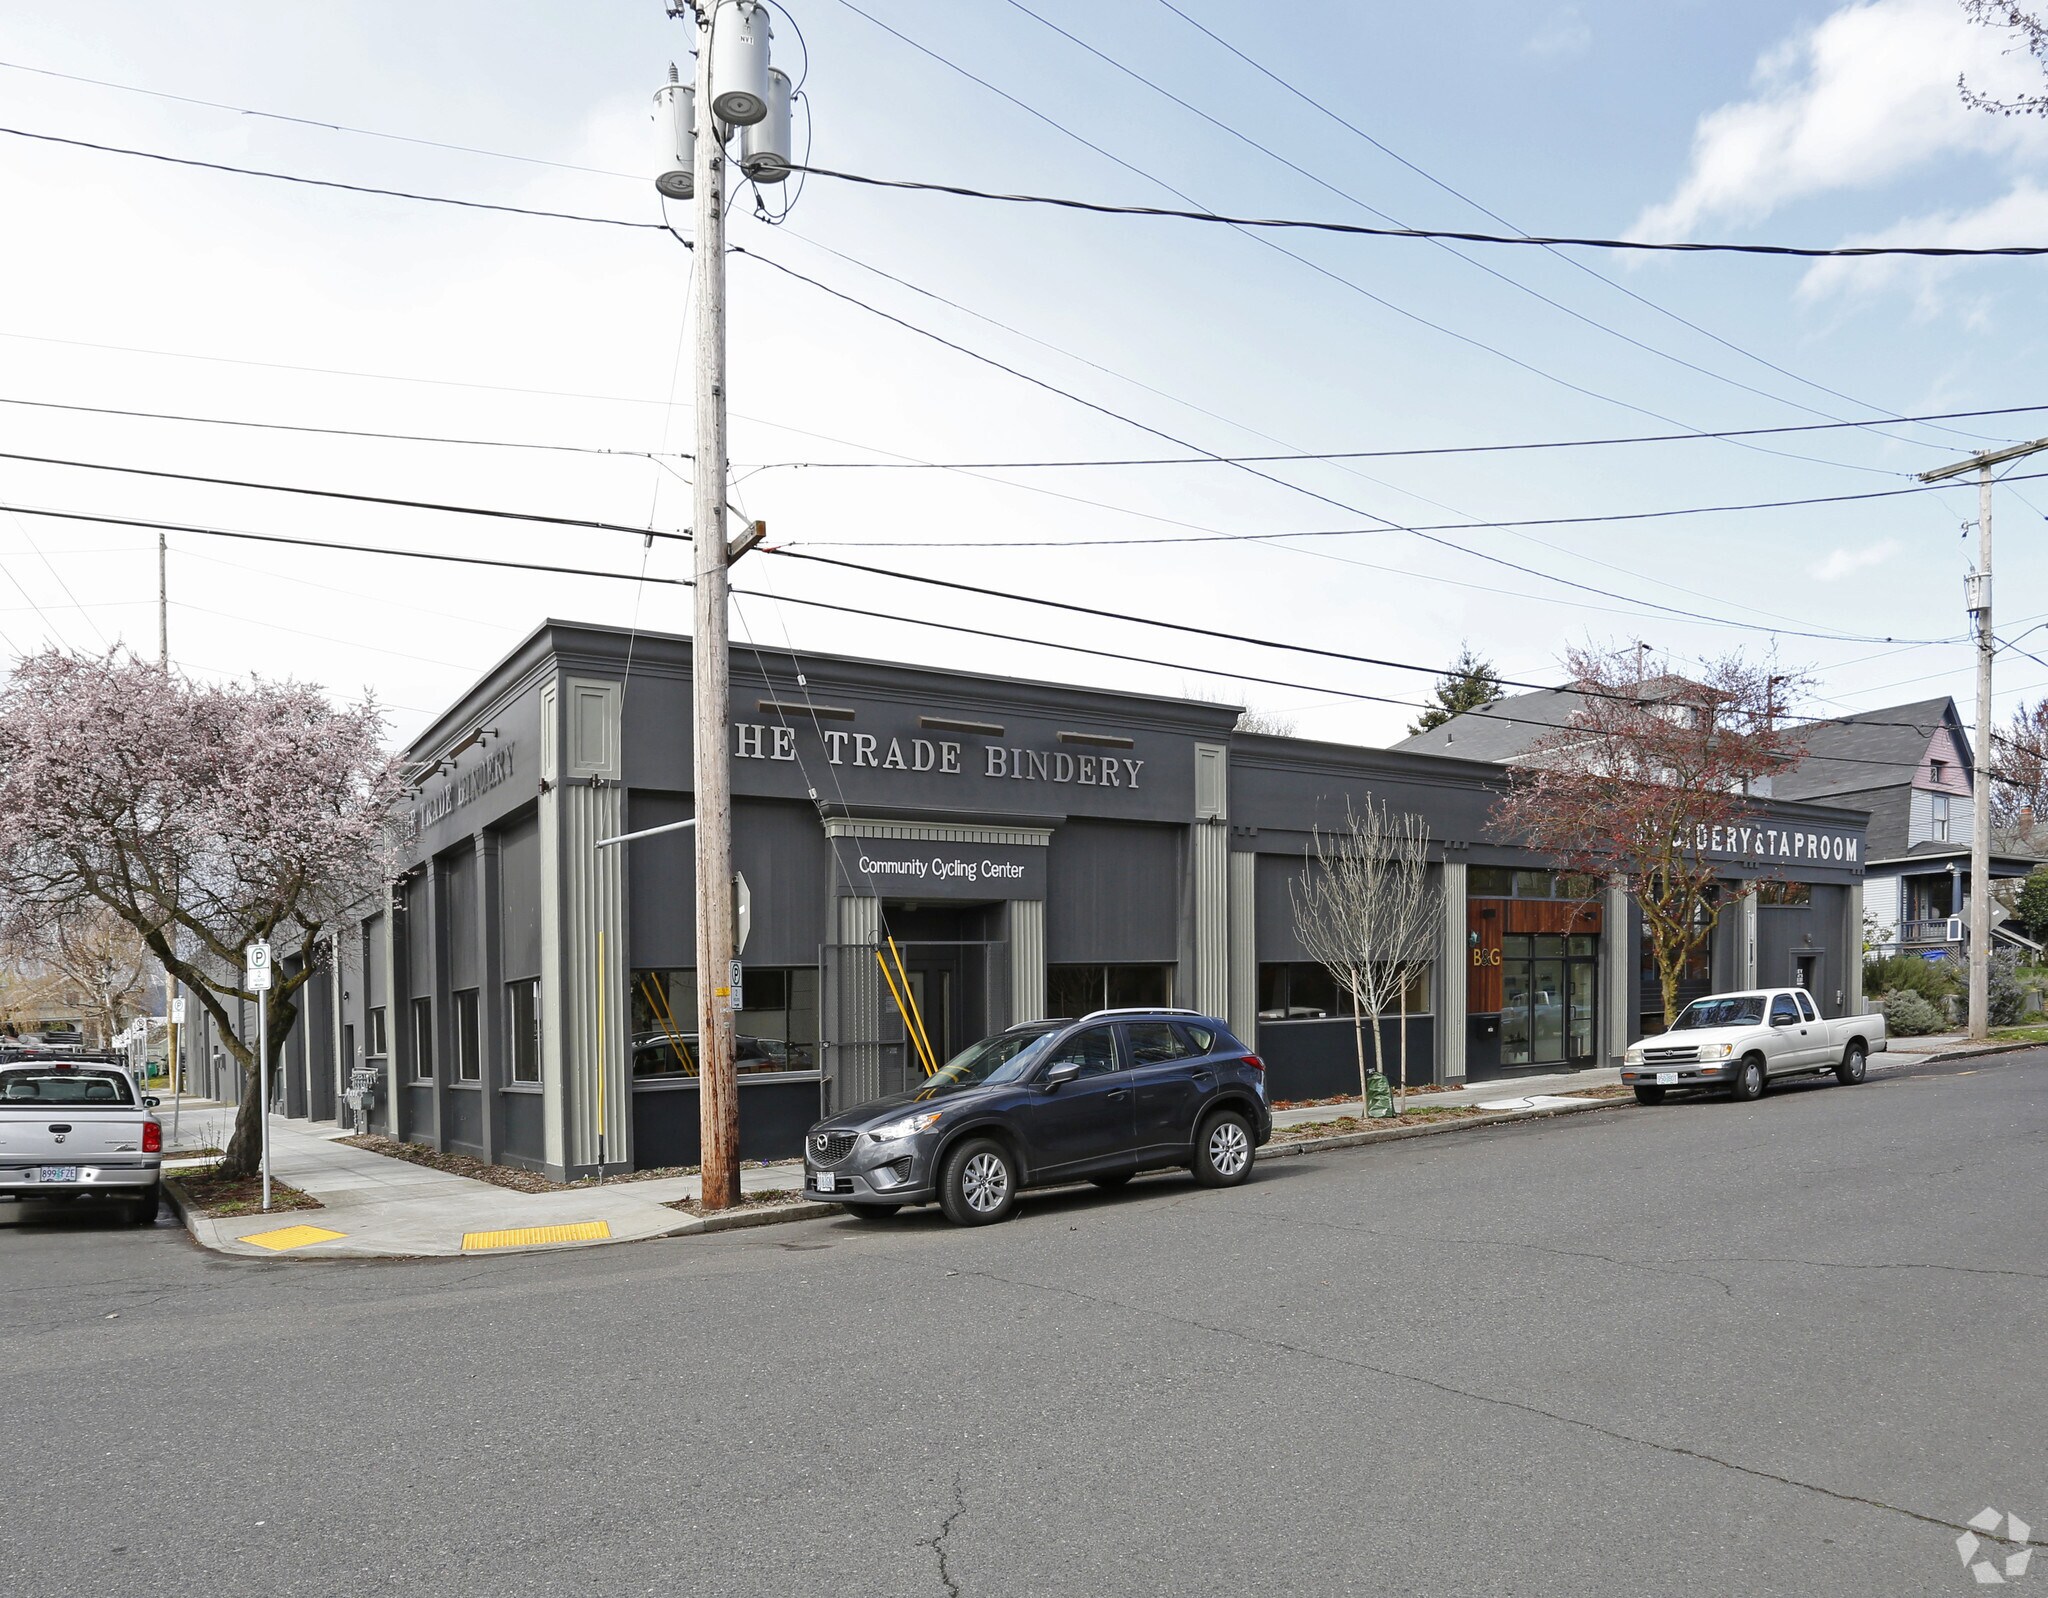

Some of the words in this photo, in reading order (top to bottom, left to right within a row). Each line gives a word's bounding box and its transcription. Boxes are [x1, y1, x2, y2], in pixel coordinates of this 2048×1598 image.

[734, 723, 796, 761] HE
[824, 730, 961, 774] TRADE
[985, 745, 1145, 789] BINDERY
[419, 784, 453, 829] TRADE
[457, 741, 515, 808] BINDERY
[858, 856, 928, 878] Community
[931, 858, 977, 881] Cycling
[981, 859, 1025, 878] Center
[1473, 948, 1500, 967] B&G
